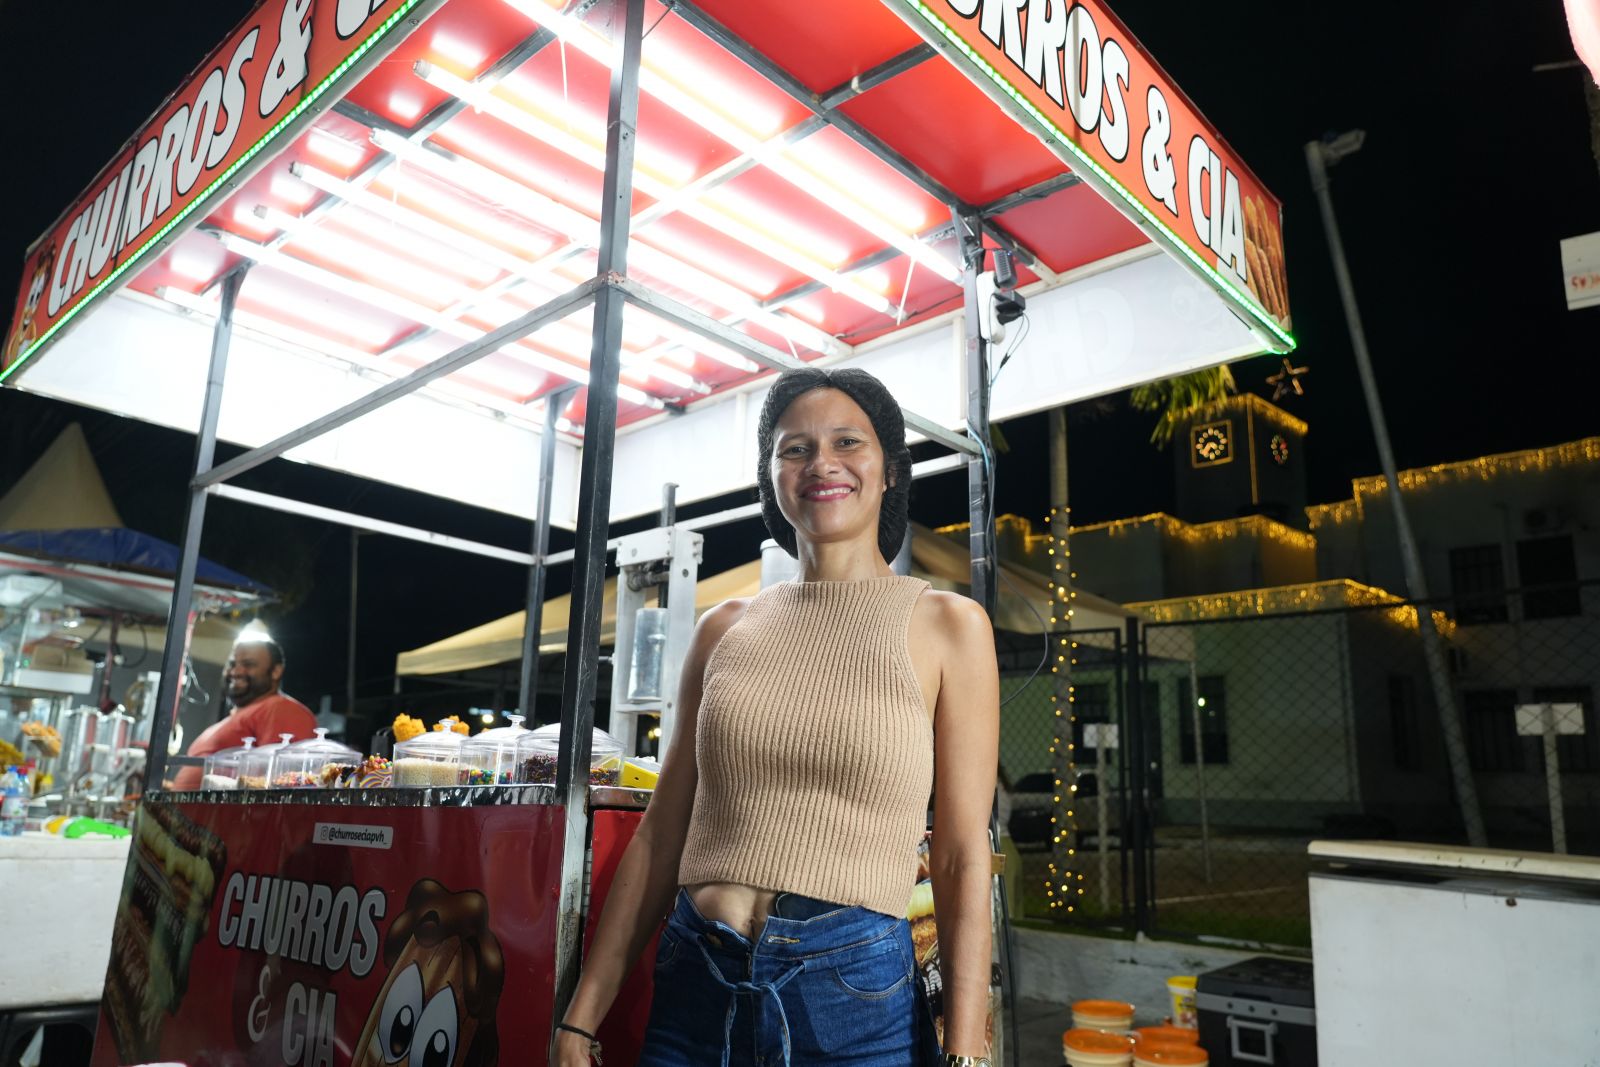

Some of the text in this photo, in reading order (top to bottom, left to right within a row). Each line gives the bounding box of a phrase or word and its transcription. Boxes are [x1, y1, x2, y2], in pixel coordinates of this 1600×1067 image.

[47, 0, 314, 318] CHURROS &
[947, 0, 1248, 284] RROS & CIA
[217, 871, 387, 978] CHURROS
[247, 964, 337, 1067] & CIA
